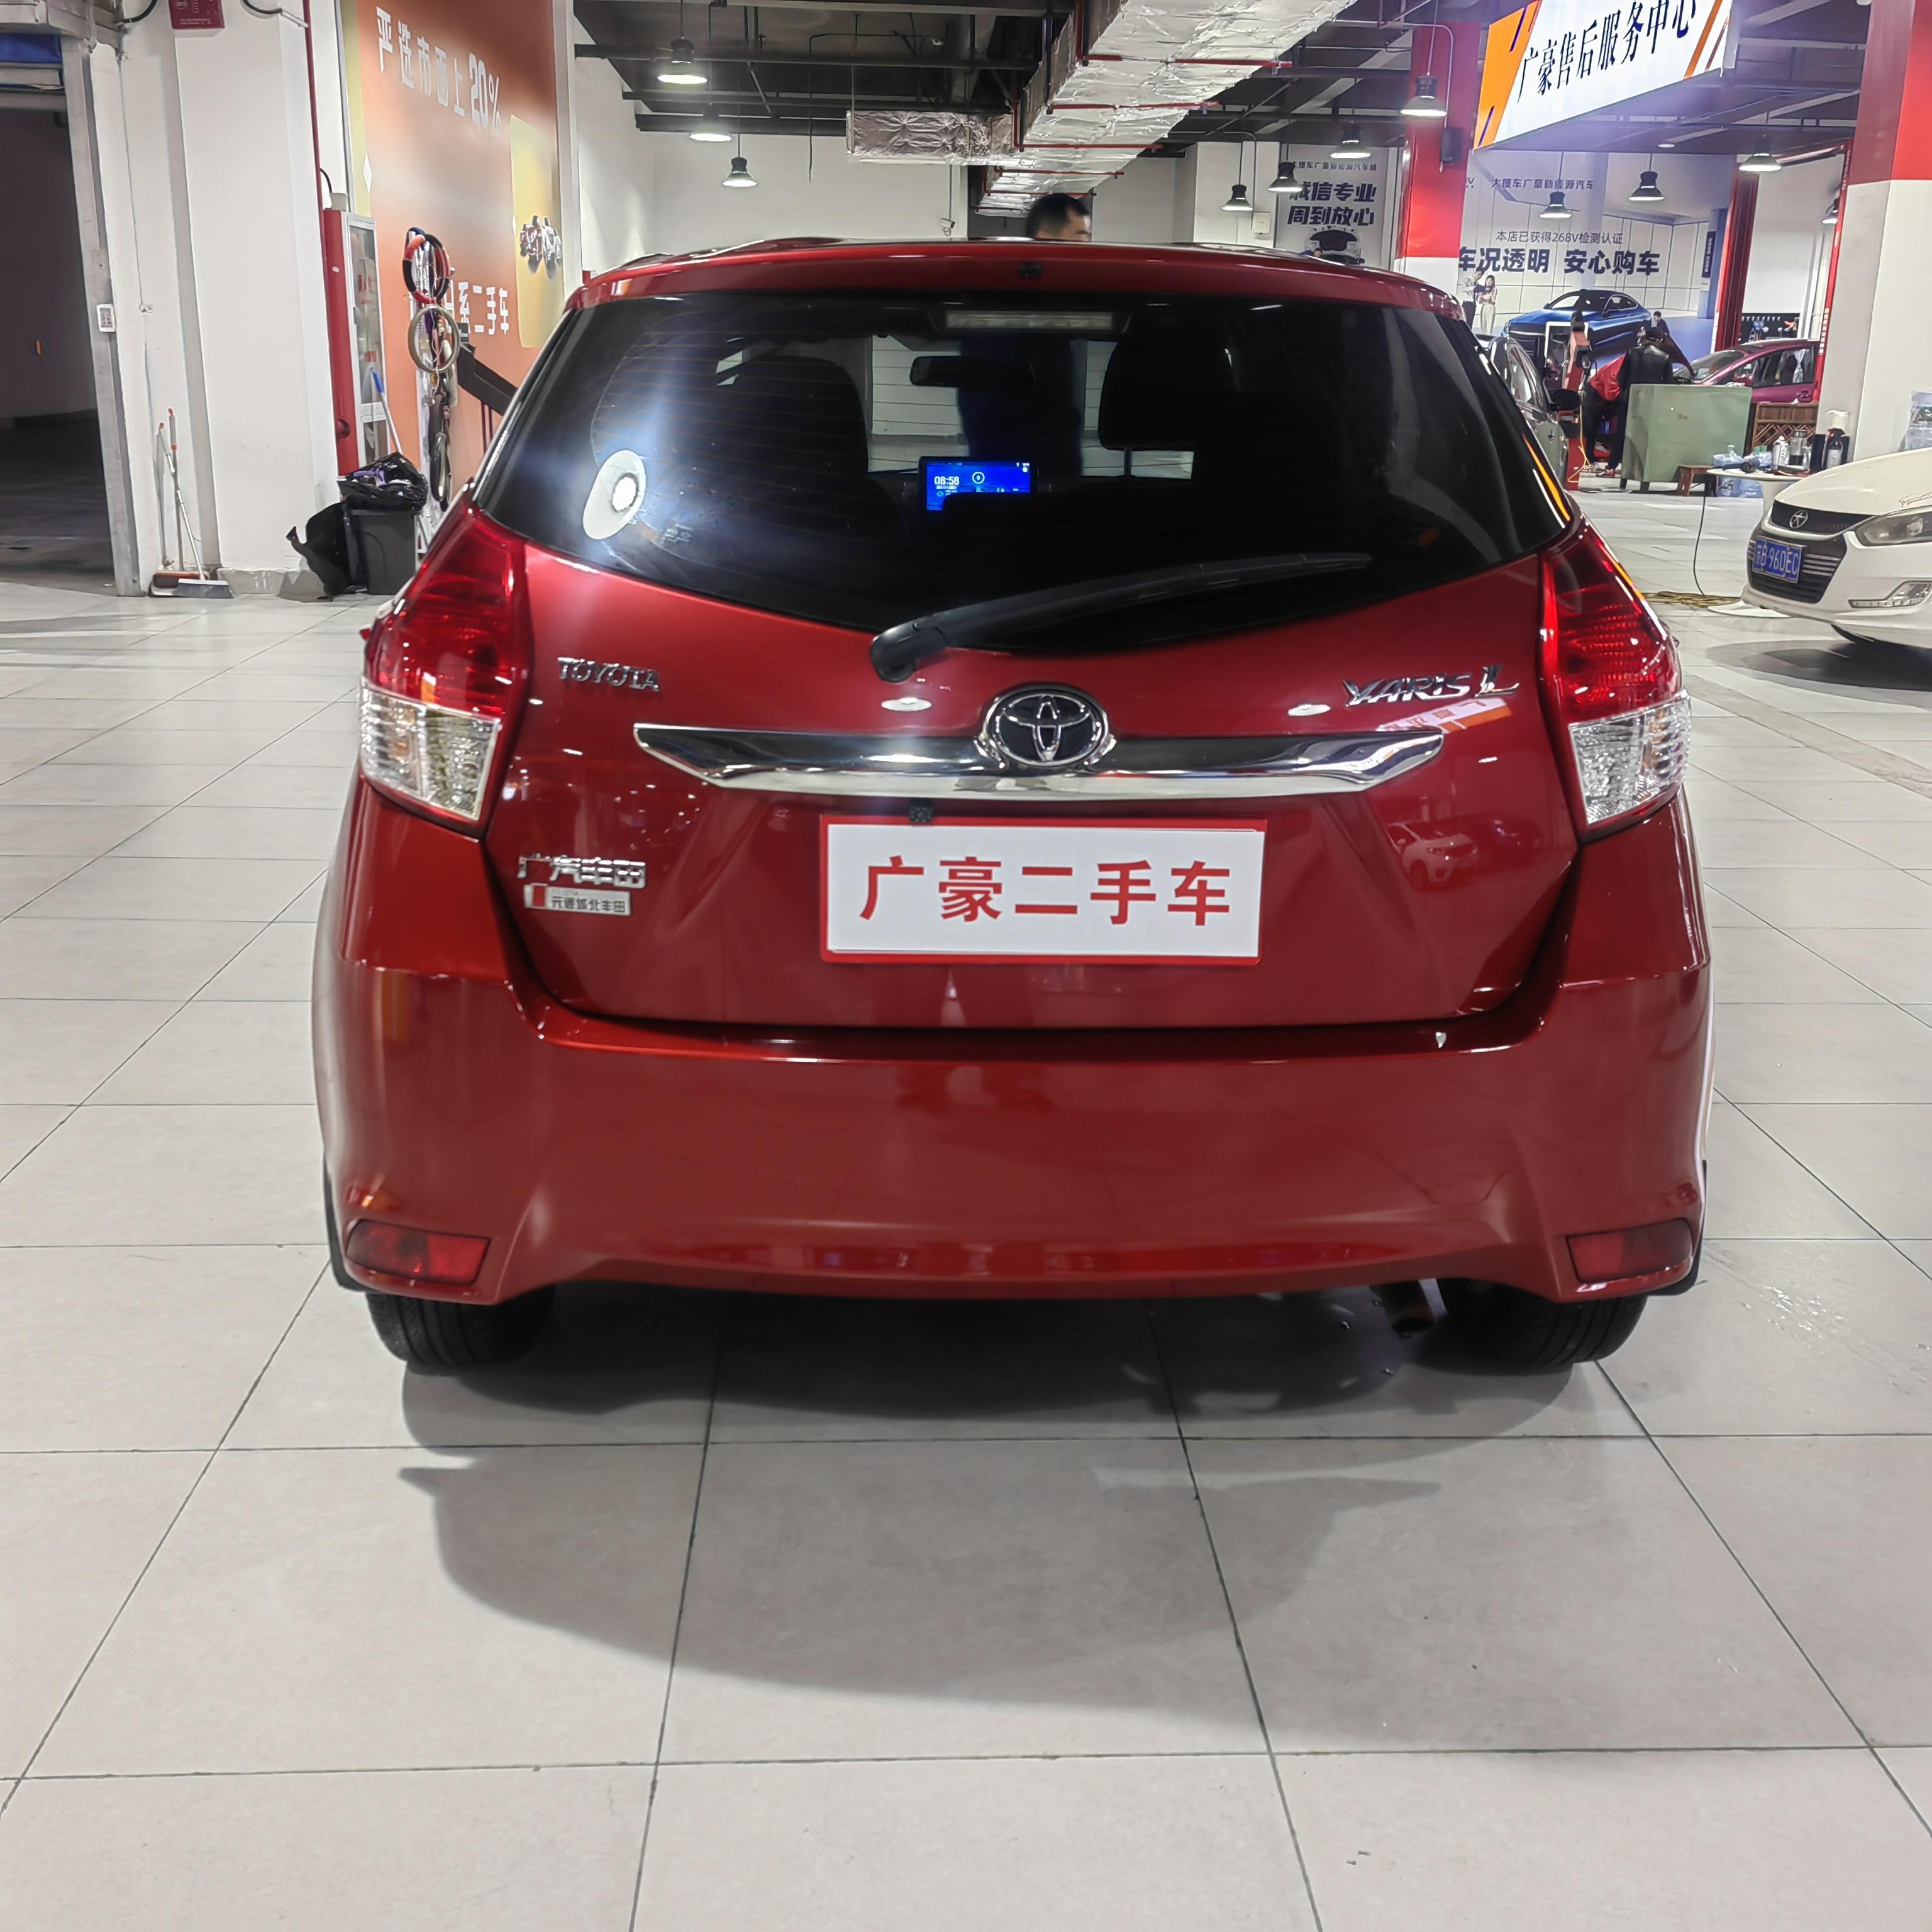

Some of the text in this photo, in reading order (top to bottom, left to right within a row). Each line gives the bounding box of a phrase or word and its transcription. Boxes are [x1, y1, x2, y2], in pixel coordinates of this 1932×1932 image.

[1517, 0, 1696, 104] 广豪售后服务中心
[1287, 205, 1375, 226] 周到放心
[1495, 230, 1624, 245] 本店已获得268V检测认证
[1458, 246, 1661, 275] 车况透明 安心购车
[934, 475, 960, 486] 08:58
[557, 657, 660, 692] TOYOTA
[1343, 663, 1520, 708] YARIS L
[517, 853, 647, 889] 广汽丰田
[859, 855, 1231, 926] 广豪二手车
